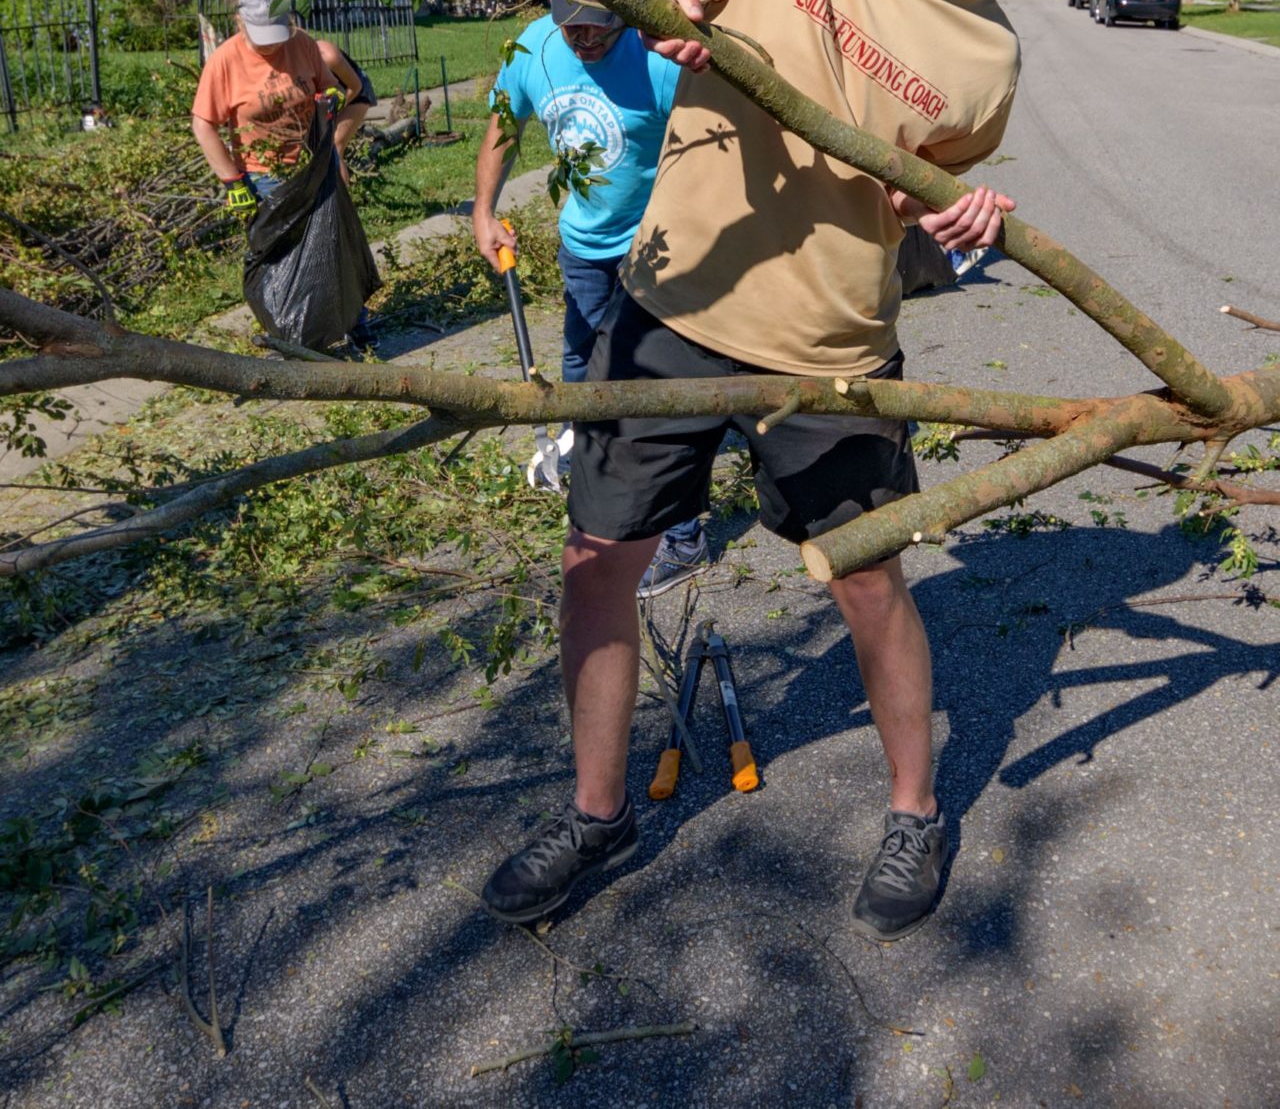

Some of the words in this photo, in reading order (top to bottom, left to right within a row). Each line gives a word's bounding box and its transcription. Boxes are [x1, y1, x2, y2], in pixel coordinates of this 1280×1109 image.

[833, 20, 907, 92] FUNDING
[903, 76, 946, 121] COACH
[546, 98, 577, 120] NOLA
[580, 96, 596, 108] ON
[597, 104, 616, 129] TAP
